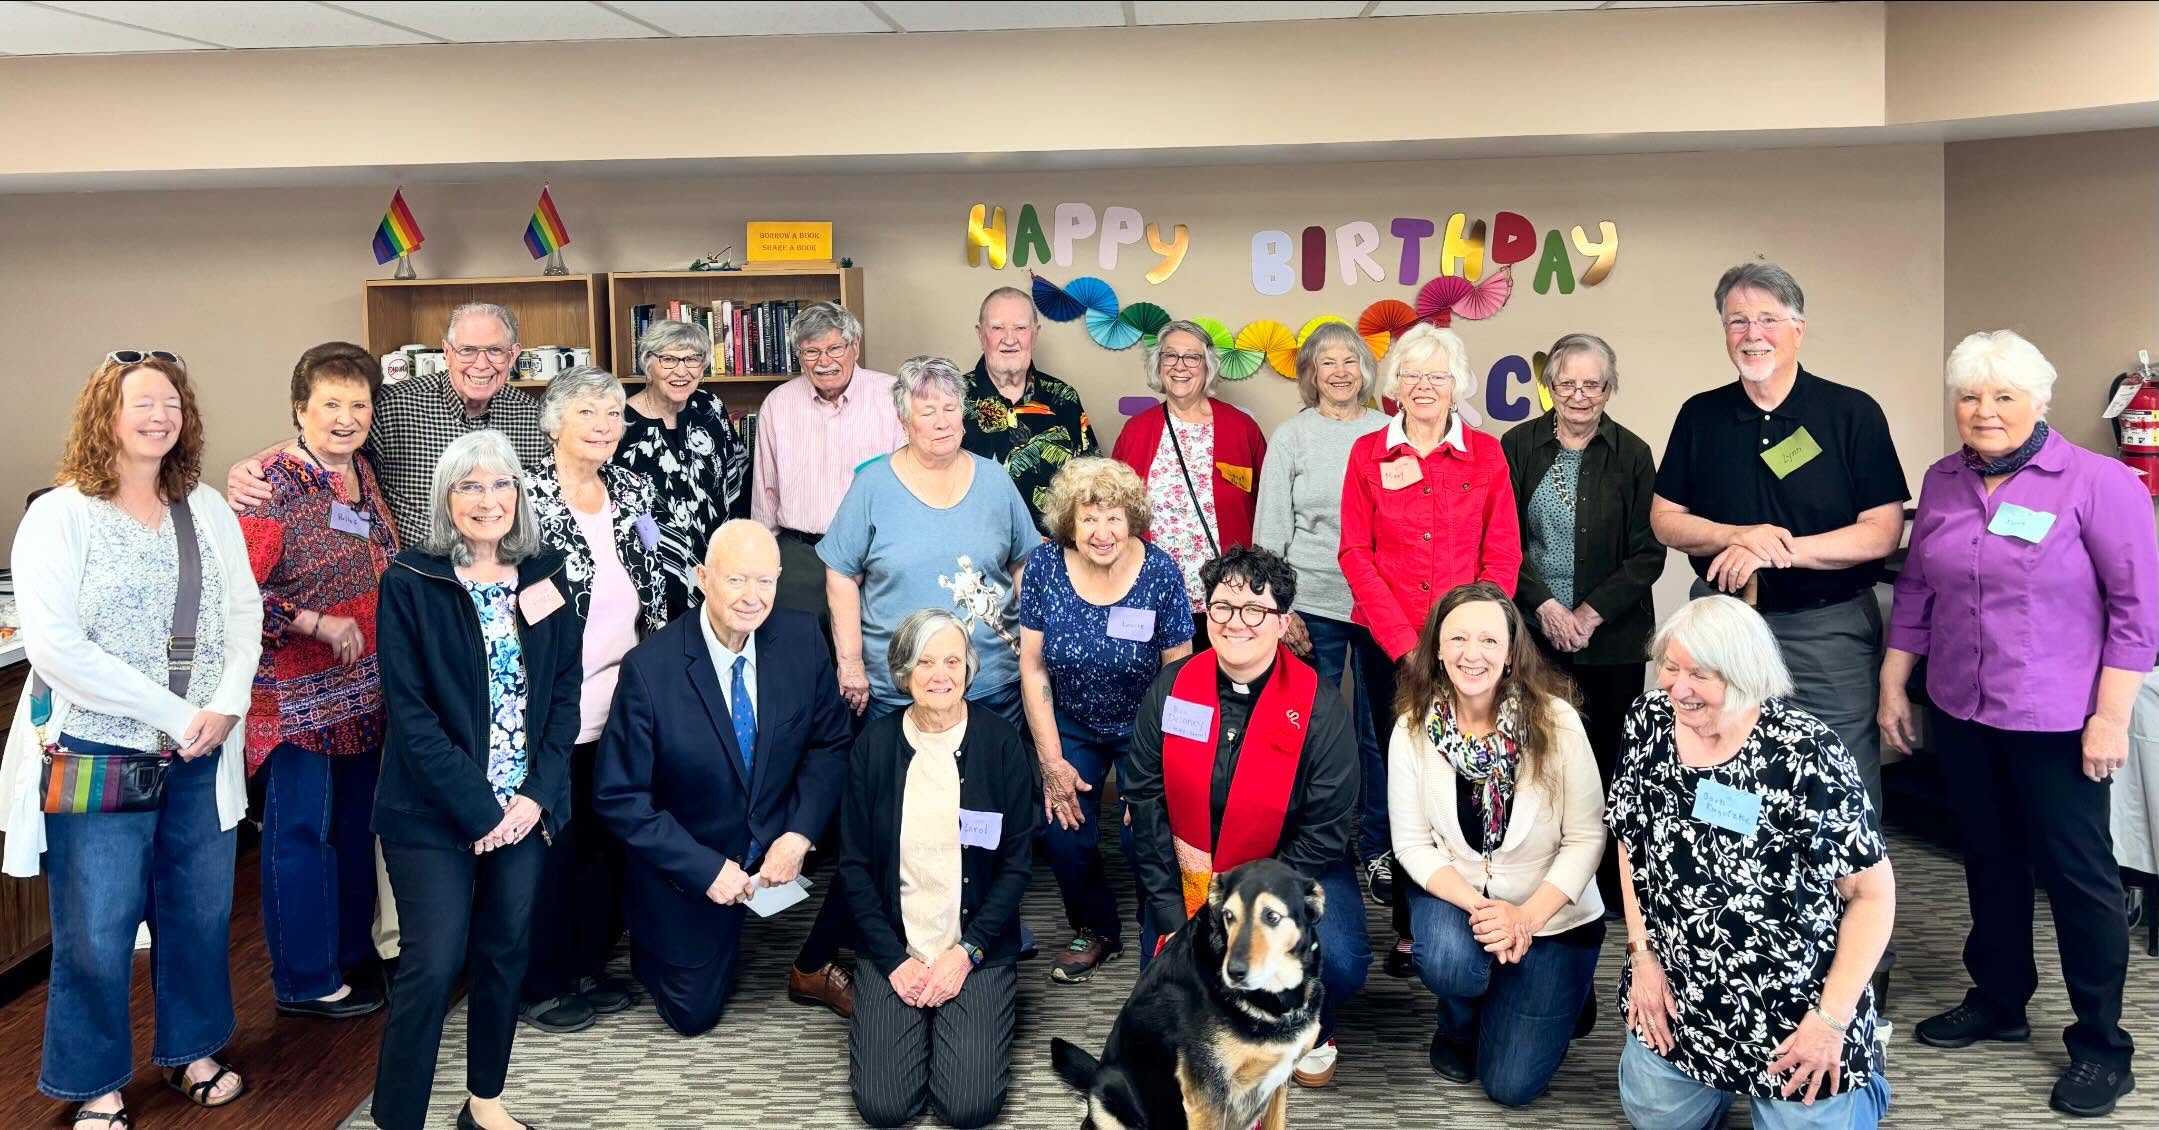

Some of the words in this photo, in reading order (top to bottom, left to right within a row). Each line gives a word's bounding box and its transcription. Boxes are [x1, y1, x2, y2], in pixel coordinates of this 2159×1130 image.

[967, 203, 1190, 285] HAPPY
[1251, 211, 1619, 295] BIRTHDAY
[1782, 447, 1803, 464] Lynn
